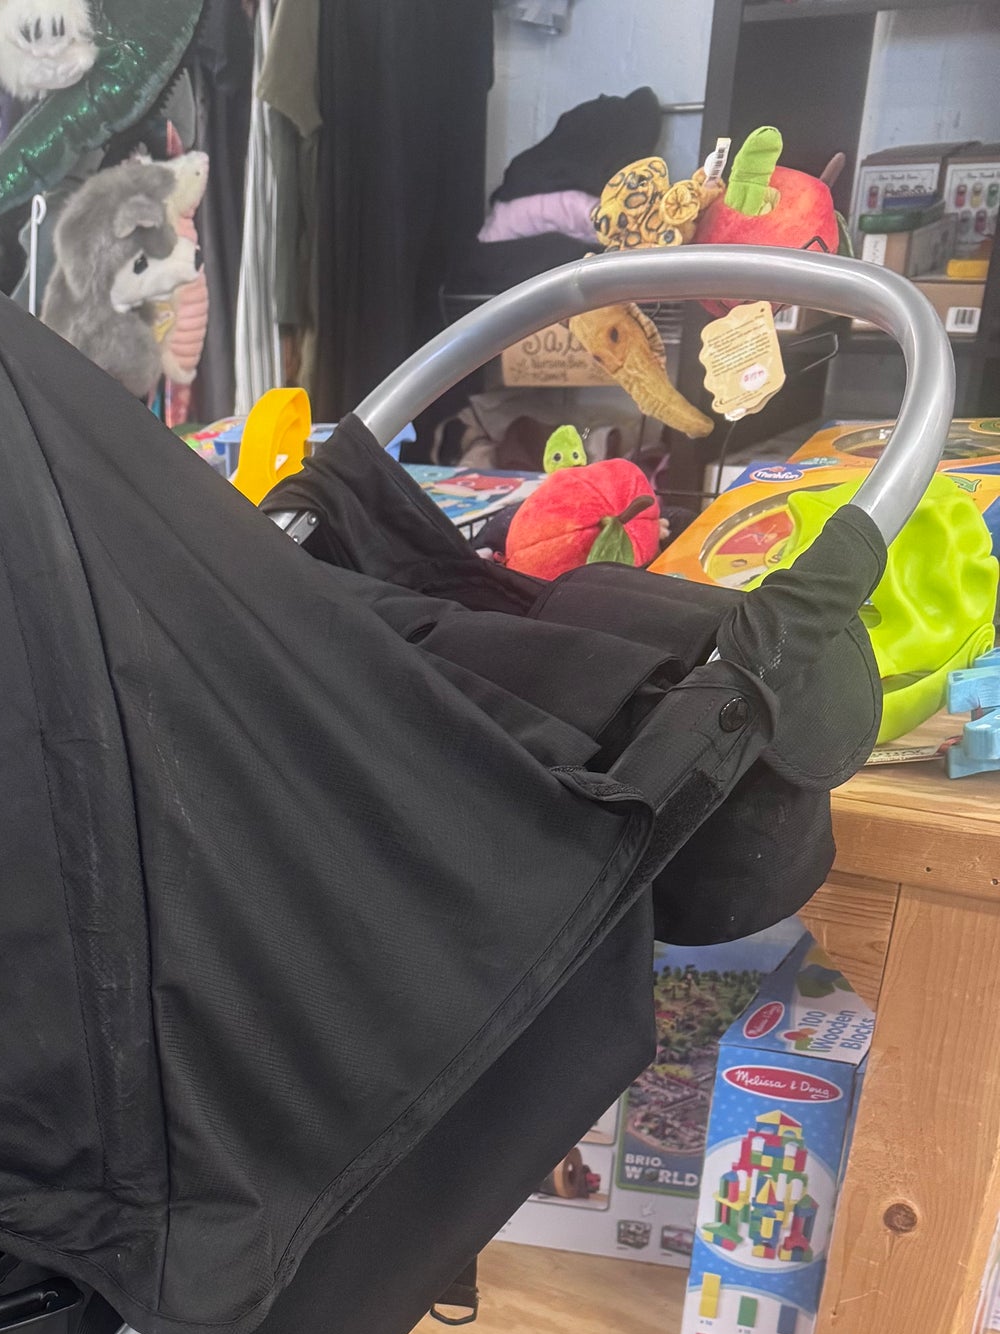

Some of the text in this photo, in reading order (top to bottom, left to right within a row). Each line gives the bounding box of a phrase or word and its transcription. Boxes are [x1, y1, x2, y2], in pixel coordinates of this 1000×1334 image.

[798, 1010, 827, 1027] 100
[809, 1009, 857, 1049] Wooden
[839, 1017, 875, 1050] Blocks
[735, 1069, 787, 1089] Melissa
[800, 1080, 831, 1099] Doug
[625, 1153, 662, 1167] BRIO
